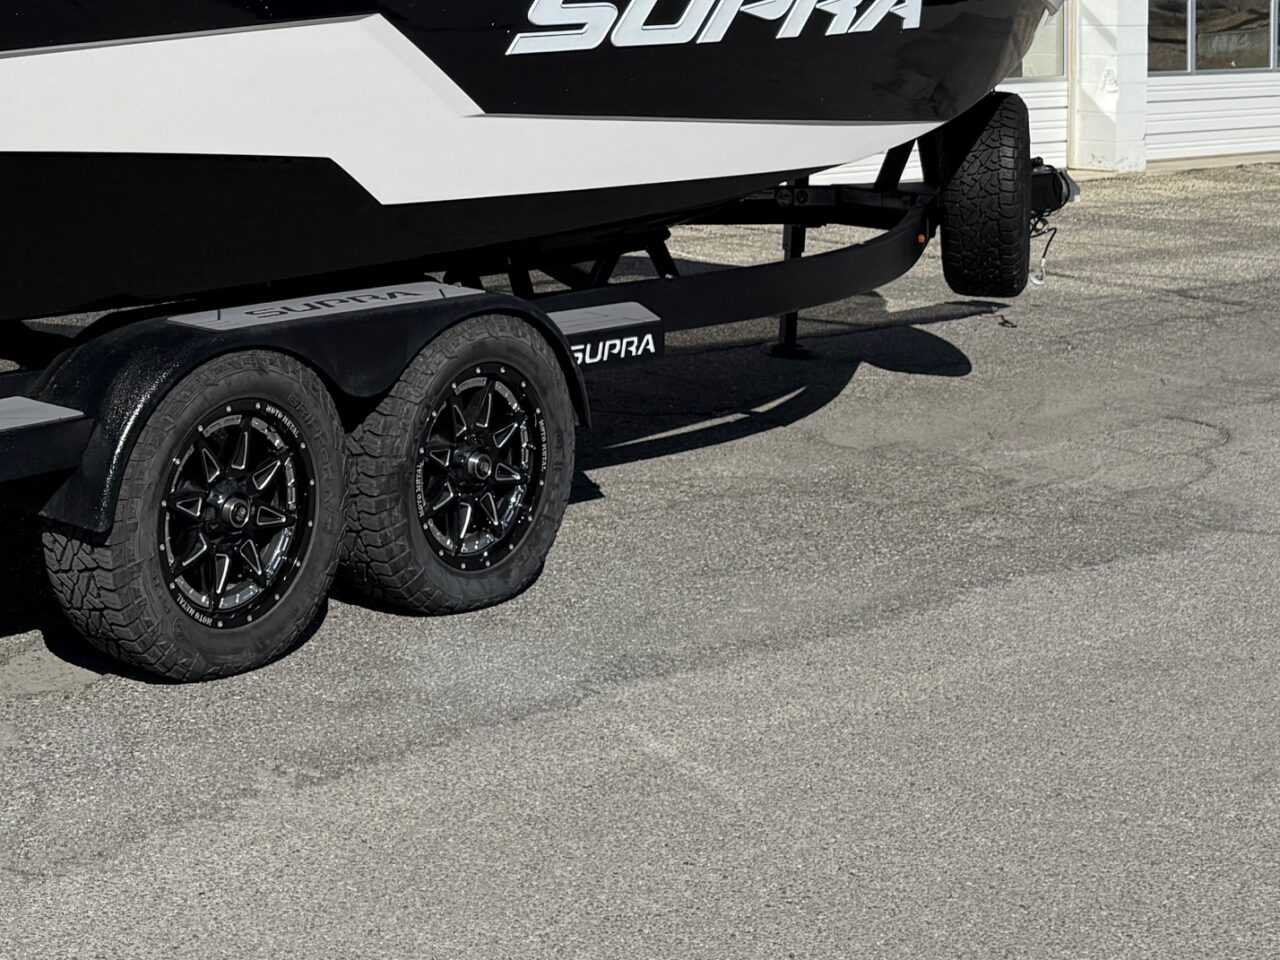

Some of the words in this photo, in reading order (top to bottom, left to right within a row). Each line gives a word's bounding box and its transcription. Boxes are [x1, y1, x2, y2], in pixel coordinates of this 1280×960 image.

[245, 291, 424, 319] SUPRA
[266, 404, 283, 419] MOTO
[282, 415, 299, 438] METAL
[177, 593, 195, 616] METAL
[194, 612, 213, 627] MOTO
